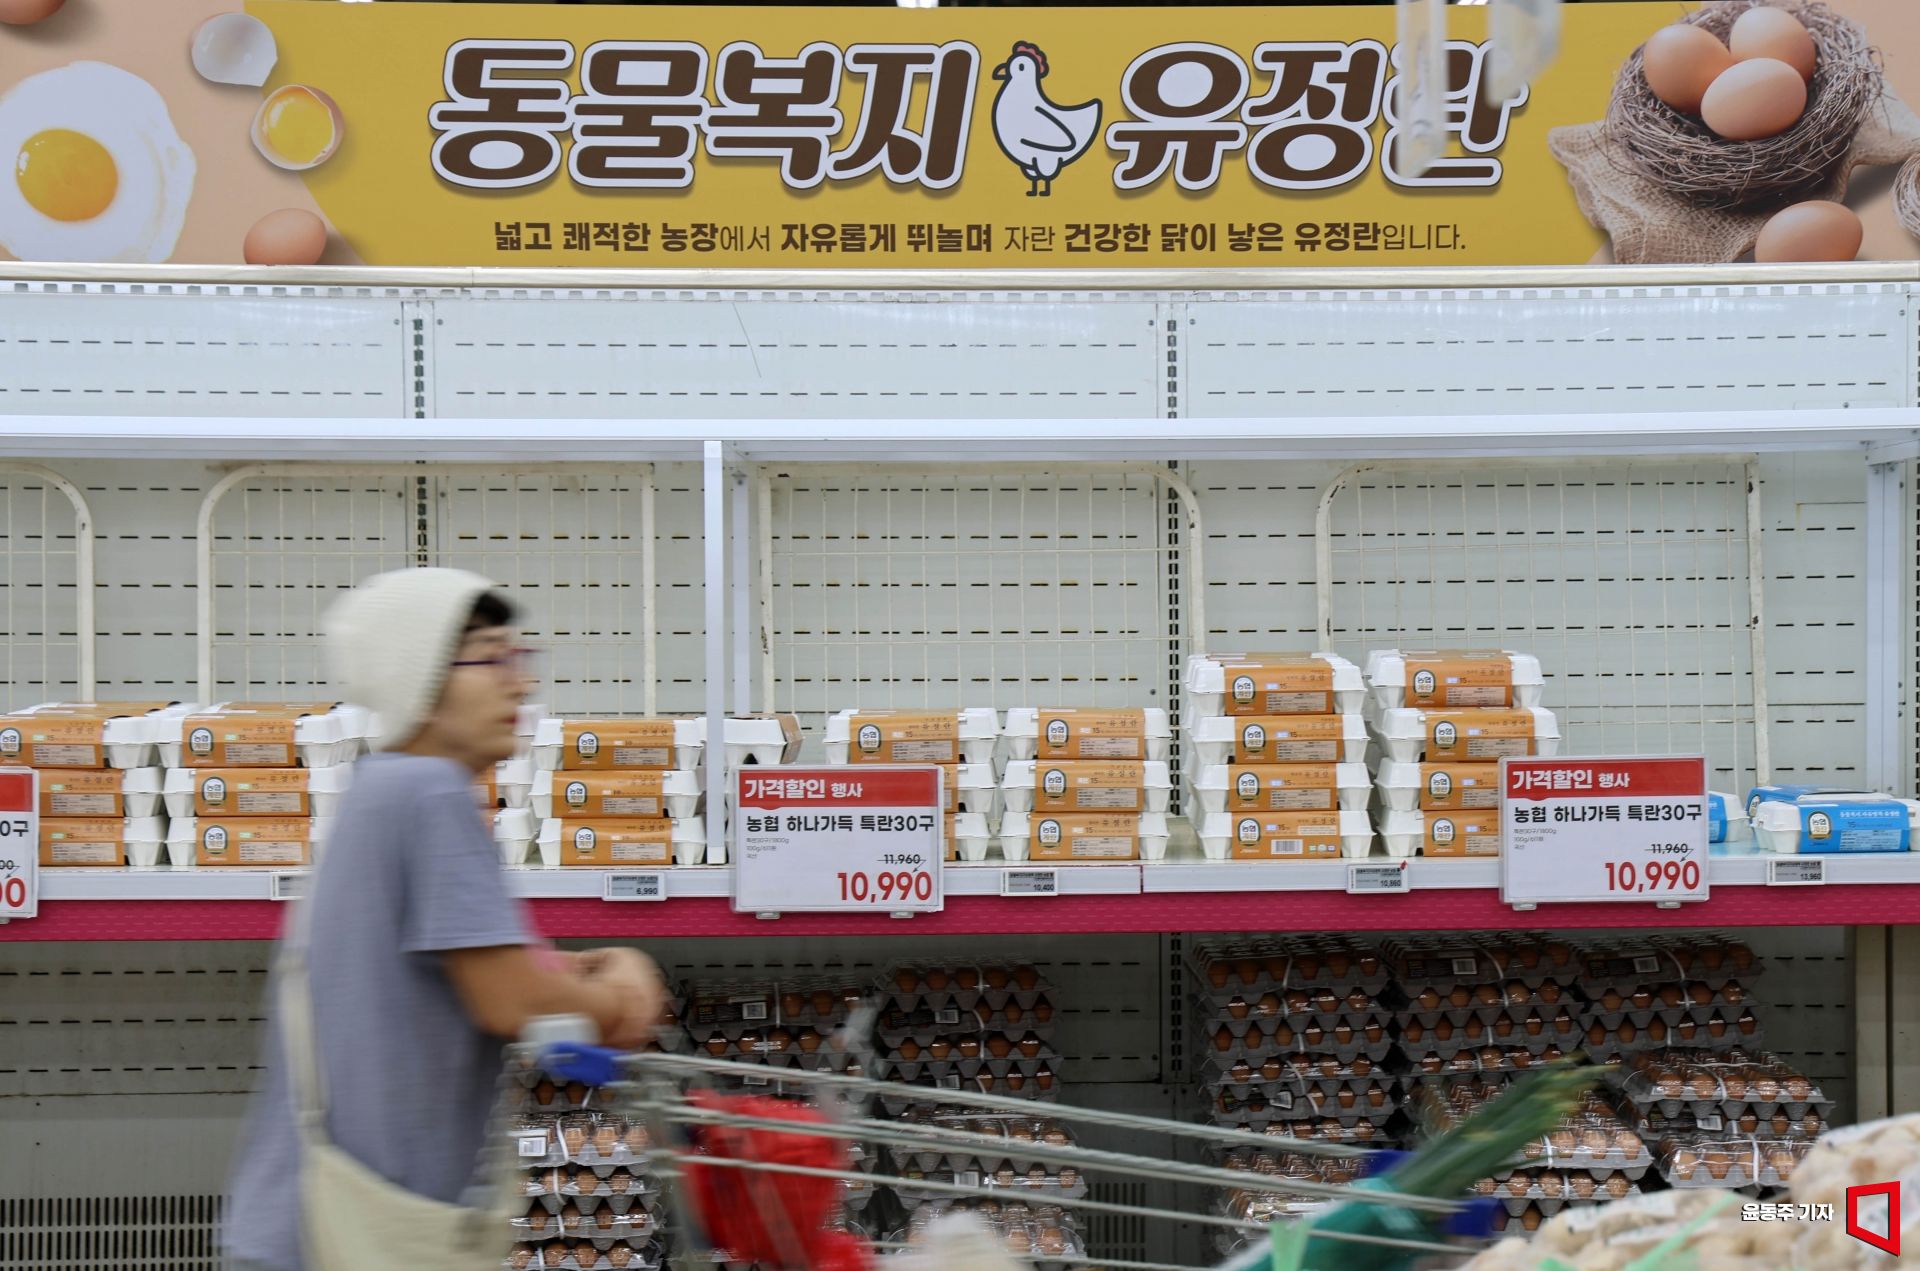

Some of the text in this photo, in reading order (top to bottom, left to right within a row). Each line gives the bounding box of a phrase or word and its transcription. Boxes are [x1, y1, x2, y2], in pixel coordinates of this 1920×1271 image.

[430, 39, 980, 188] 동물복지
[494, 222, 1466, 252] 넓고 쾌적한 농장에서 자유롭게 뛰놀며 자란 건강한 닭이 낳은 유정란입니다.
[745, 779, 863, 798] 가격할인 행사
[1512, 769, 1630, 790] 가격할인 행사
[747, 815, 934, 832] 농협 하나가득 특란30구
[1514, 804, 1702, 823] 농협 하나가득 특란30구
[1651, 843, 1688, 854] 11,960
[883, 854, 921, 865] 11,960
[1605, 860, 1700, 893] 10,990
[837, 871, 932, 903] 10,990
